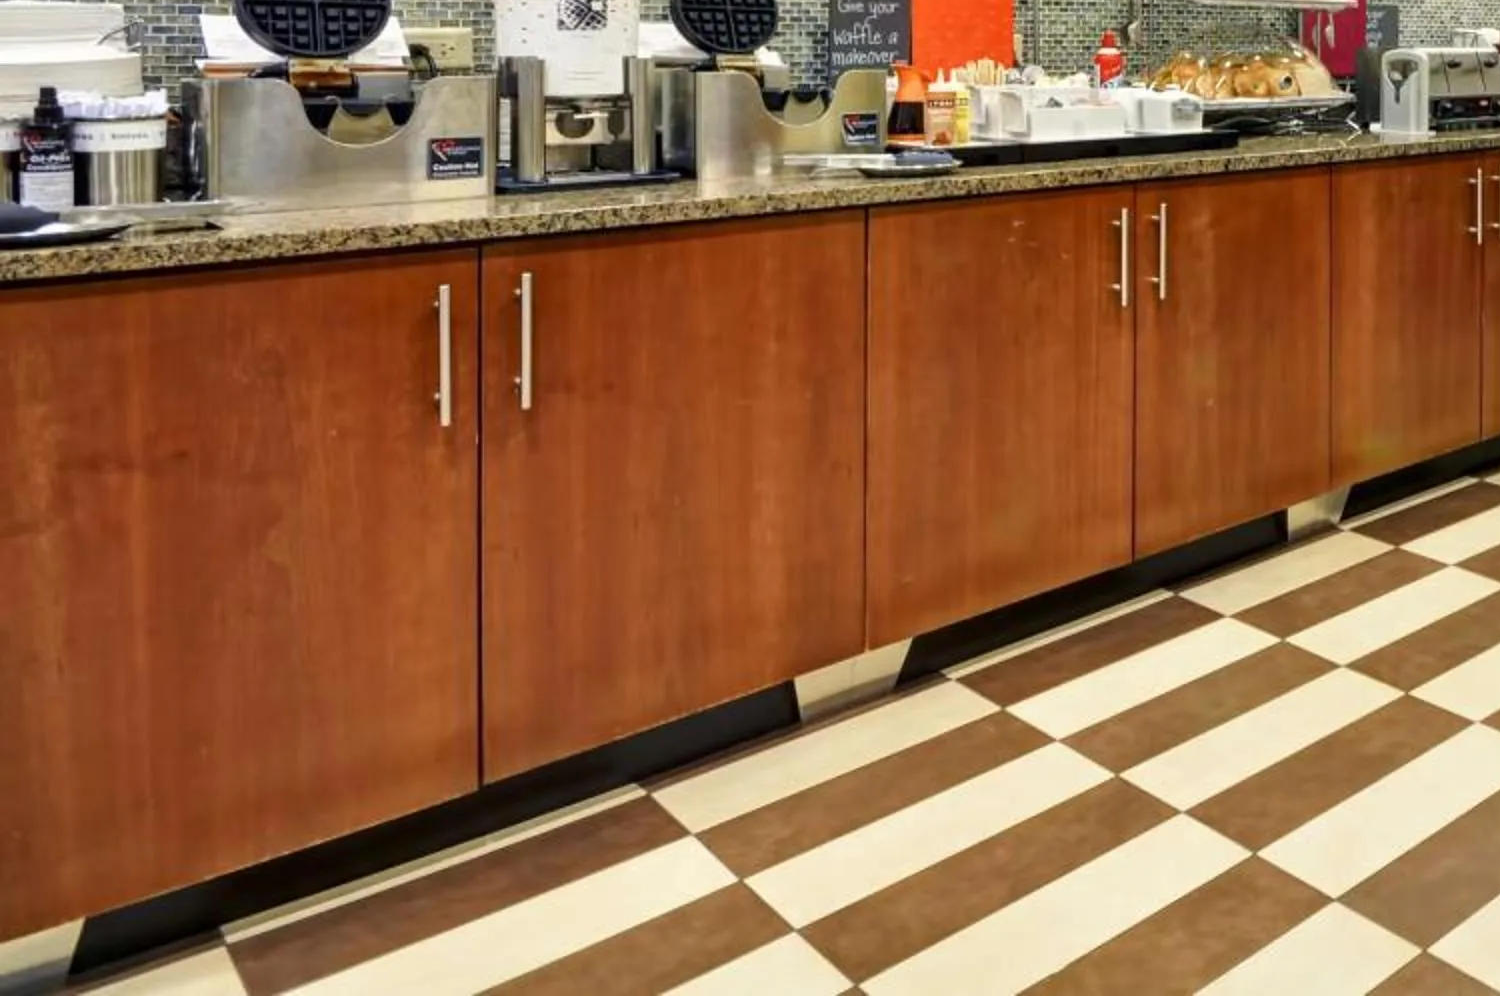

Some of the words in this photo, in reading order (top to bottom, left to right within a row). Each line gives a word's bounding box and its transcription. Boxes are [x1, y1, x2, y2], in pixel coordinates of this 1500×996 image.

[864, 2, 901, 25] your
[887, 31, 900, 45] a
[831, 48, 900, 66] makeover
